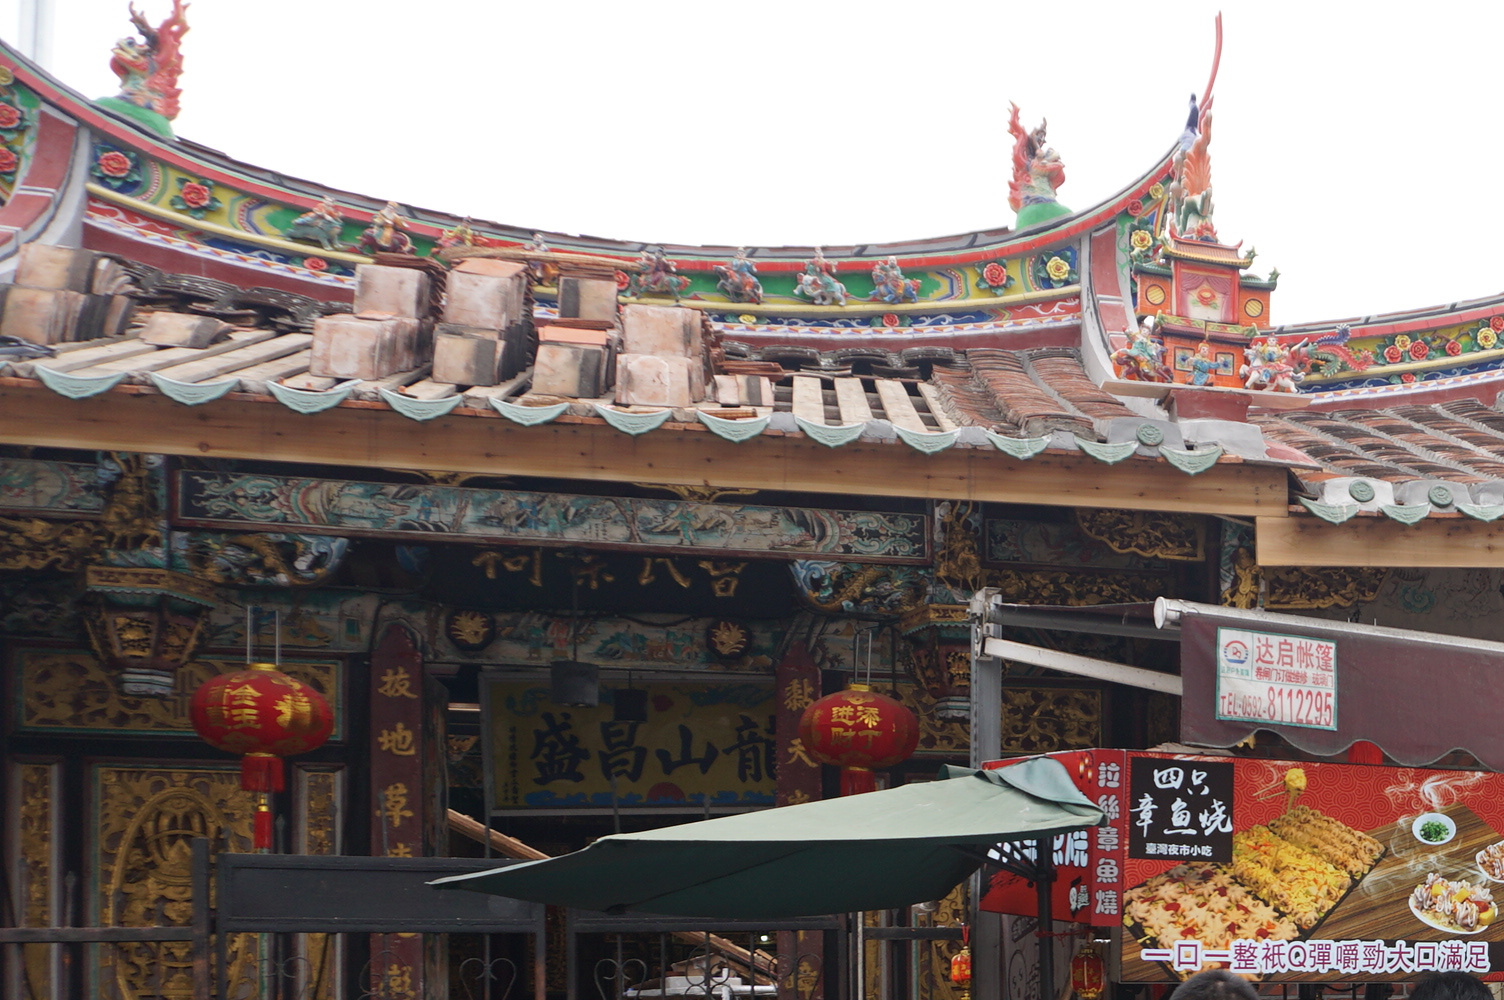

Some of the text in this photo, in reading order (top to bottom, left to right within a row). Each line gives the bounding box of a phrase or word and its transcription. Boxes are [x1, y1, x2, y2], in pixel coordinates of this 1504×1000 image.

[1255, 637, 1333, 672] 达启帐篷
[1153, 767, 1208, 796] 四只
[1095, 762, 1121, 915] 拉絲章魚燒
[1145, 842, 1213, 857] 臺灣夜市小吃
